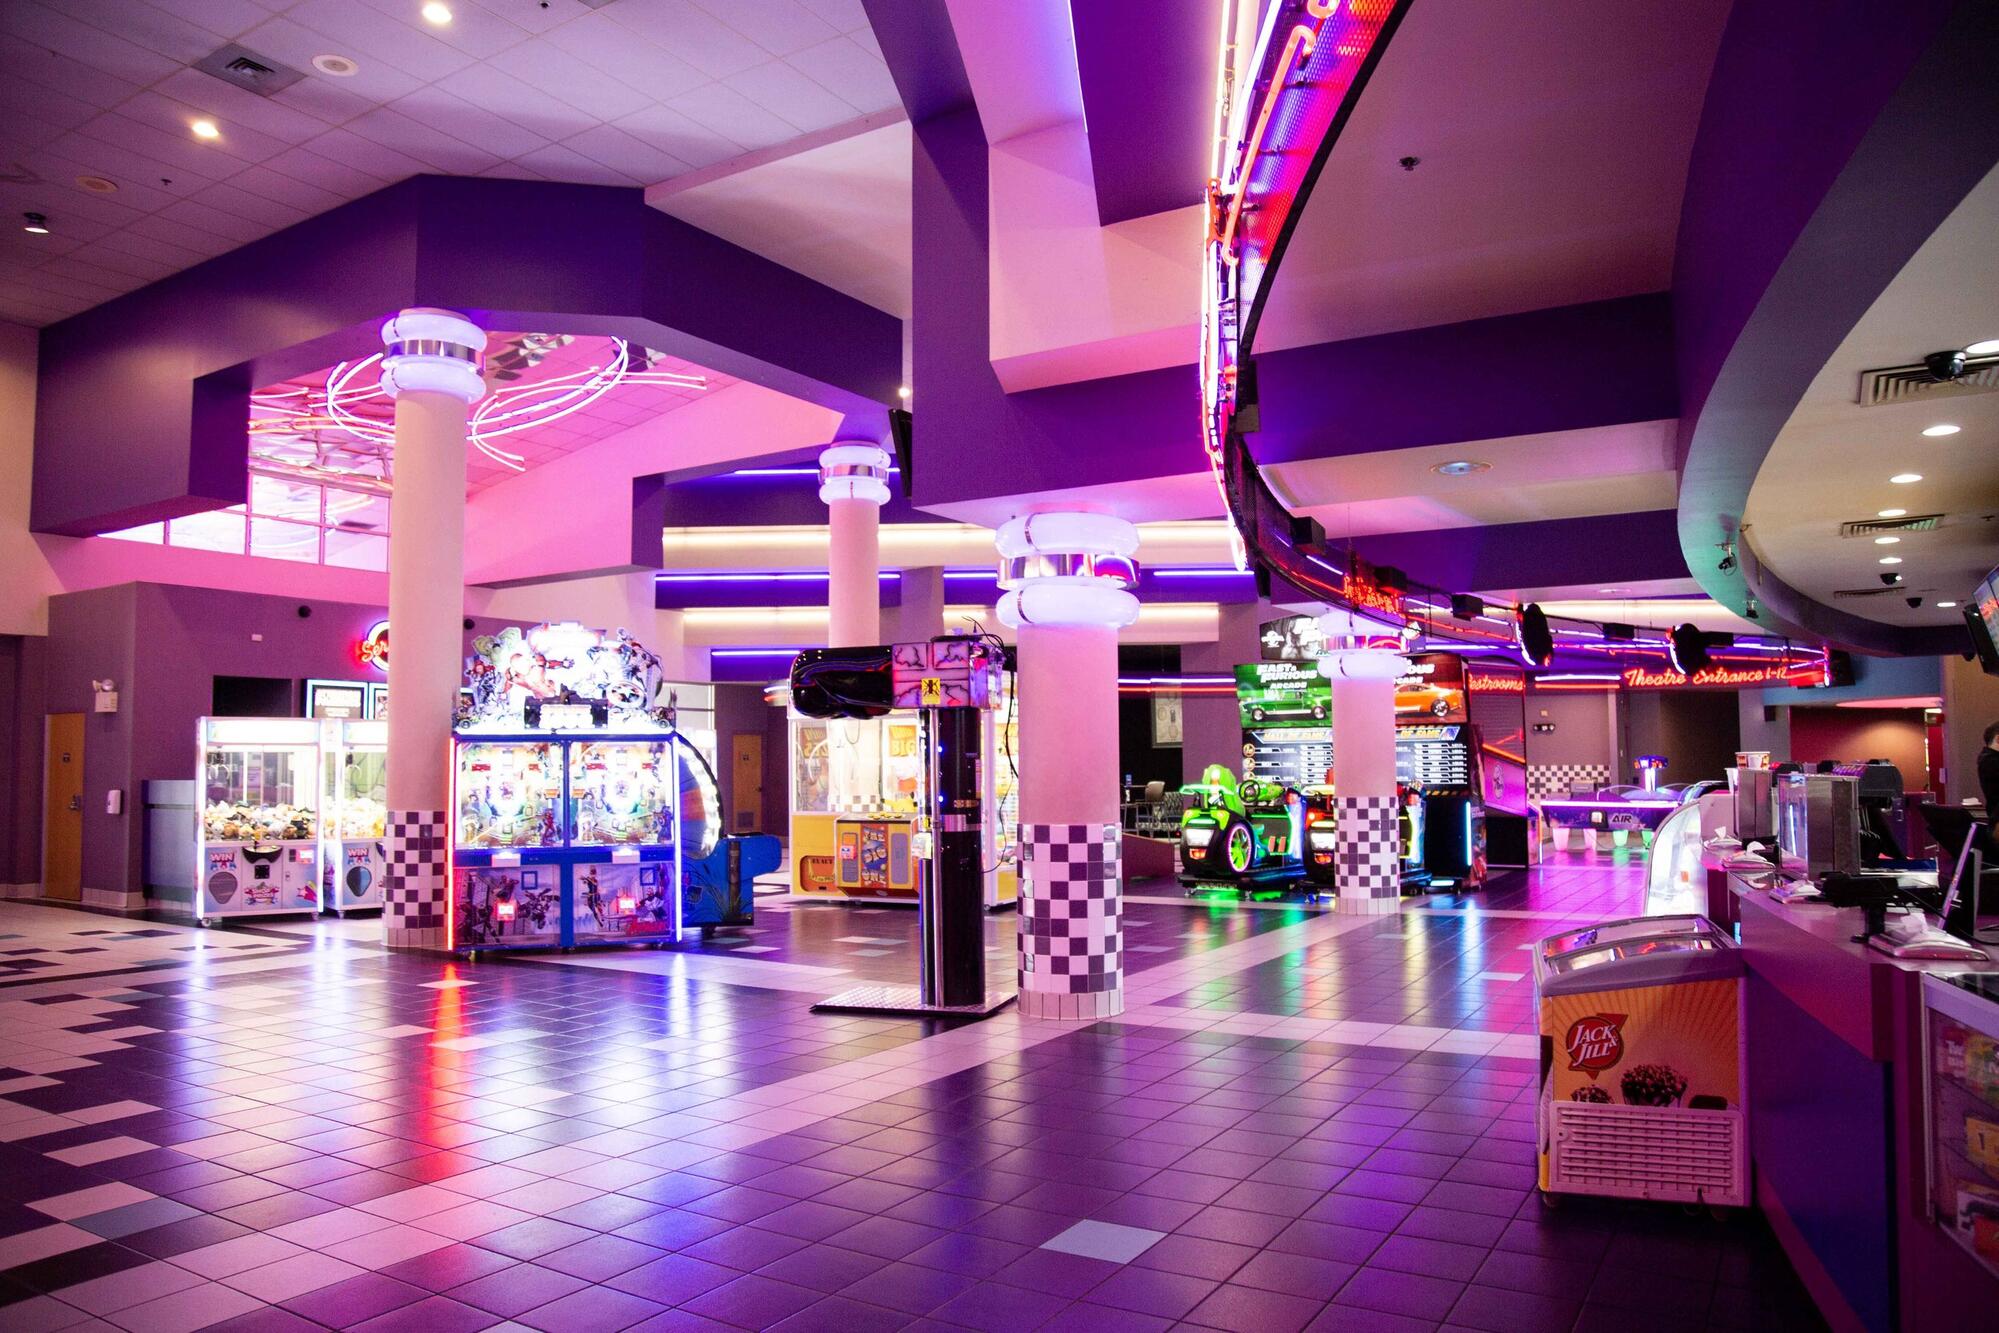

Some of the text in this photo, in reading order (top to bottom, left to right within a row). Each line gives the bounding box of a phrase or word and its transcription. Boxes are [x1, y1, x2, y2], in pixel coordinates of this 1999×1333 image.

[1261, 670, 1318, 683] FURIOUS
[1624, 668, 1687, 687] Theatre
[1693, 667, 1764, 685] Entrance
[891, 739, 917, 757] BIG
[1612, 815, 1632, 823] AIR
[210, 852, 235, 862] WIN
[347, 848, 369, 857] WIN
[1567, 1025, 1616, 1052] JACK
[1573, 1043, 1610, 1067] JILL
